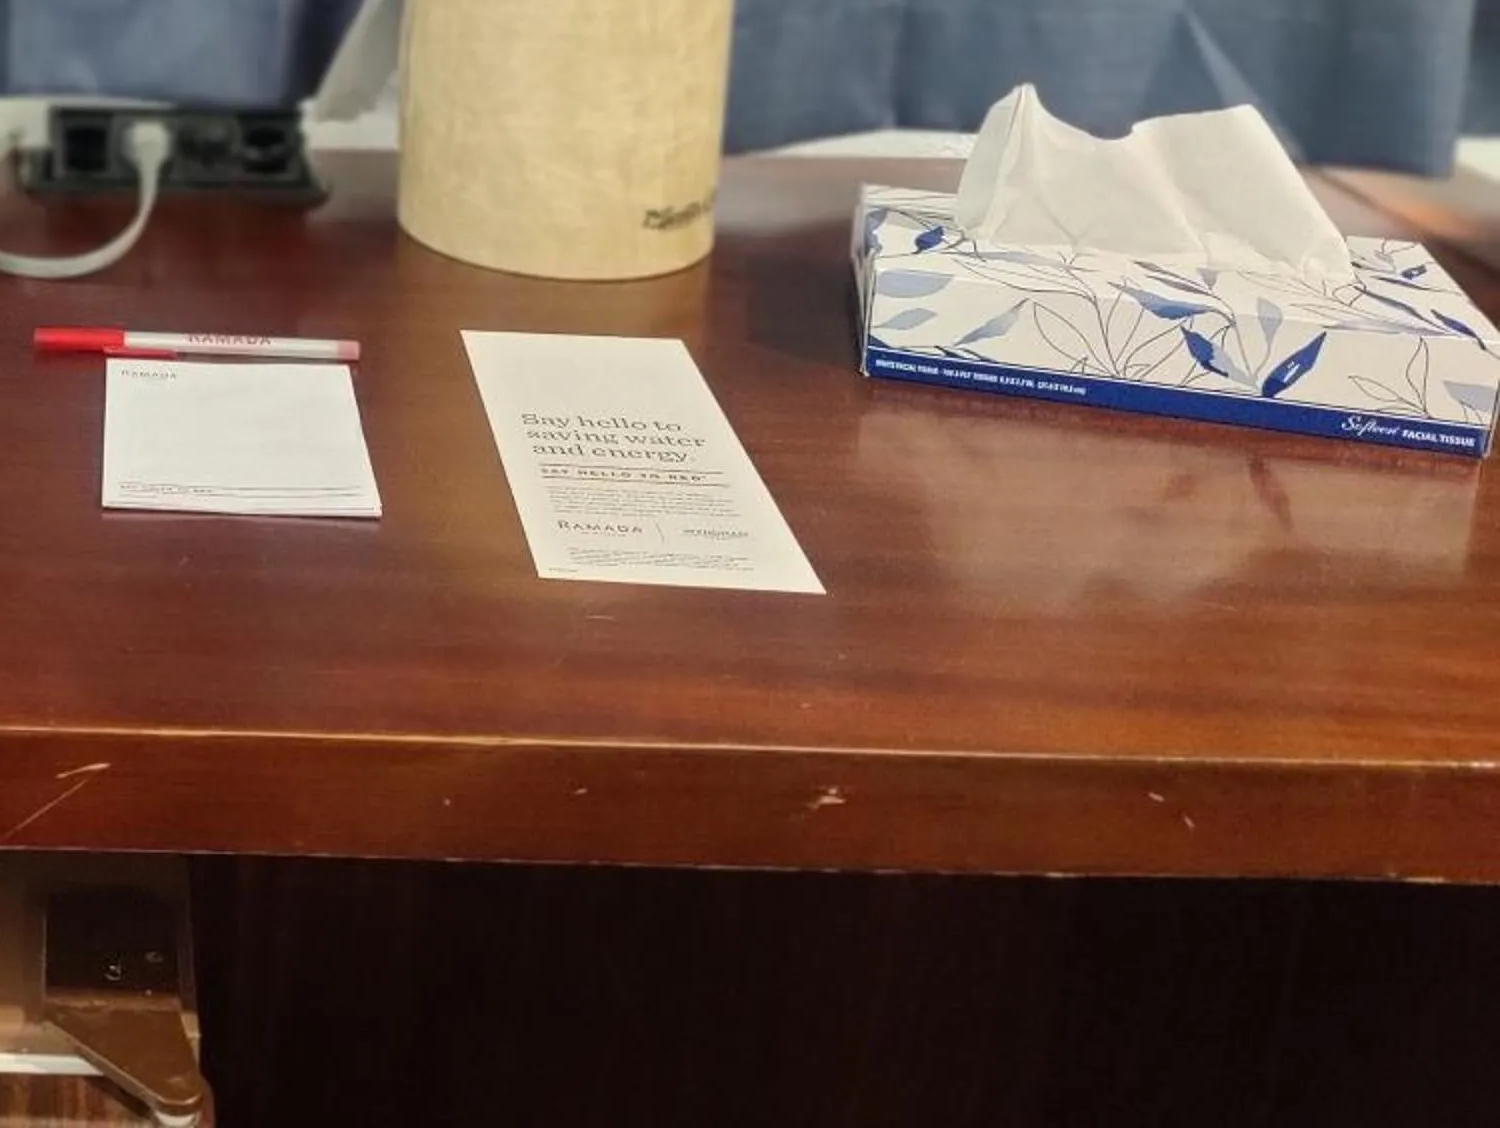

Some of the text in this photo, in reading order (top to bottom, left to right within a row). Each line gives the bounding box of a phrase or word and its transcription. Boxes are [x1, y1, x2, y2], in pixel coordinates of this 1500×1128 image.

[521, 413, 682, 433] Say hello to
[527, 429, 706, 448] saving water
[1402, 429, 1438, 443] FACIAL
[1439, 433, 1477, 447] TISSUE
[532, 443, 585, 457] and
[558, 519, 643, 534] RAMADA
